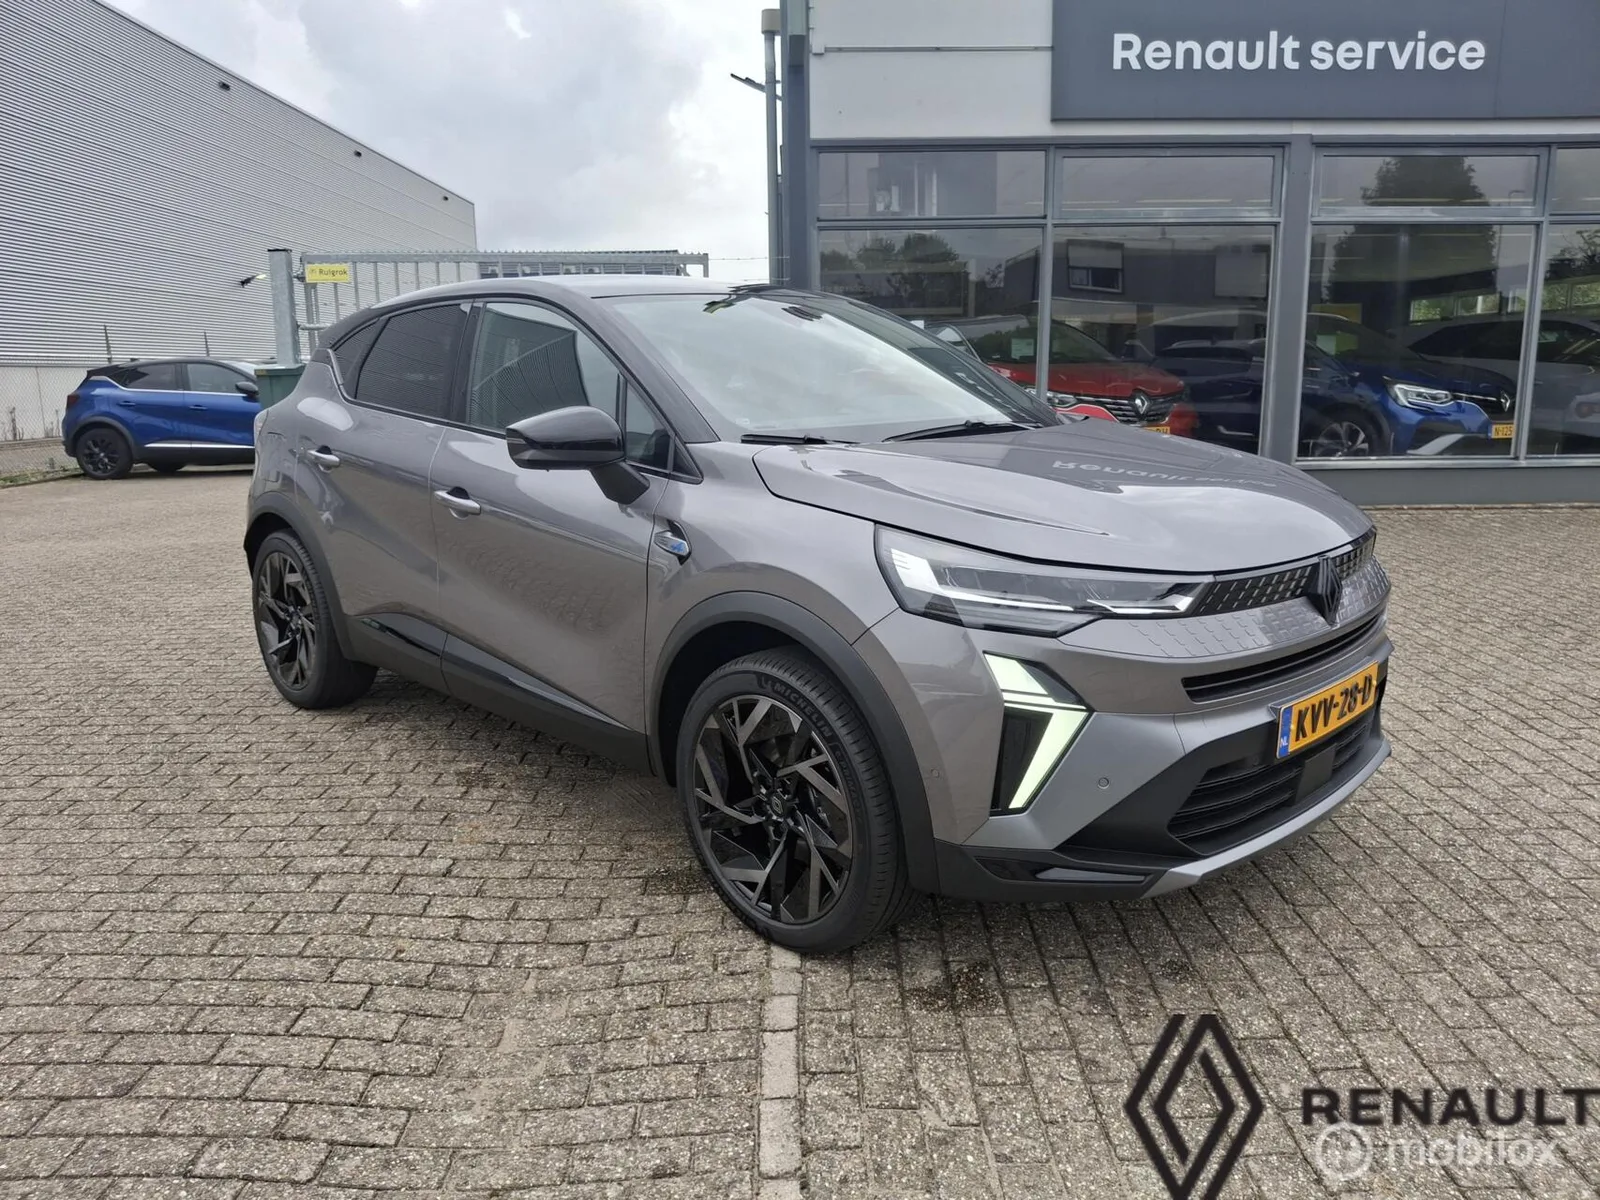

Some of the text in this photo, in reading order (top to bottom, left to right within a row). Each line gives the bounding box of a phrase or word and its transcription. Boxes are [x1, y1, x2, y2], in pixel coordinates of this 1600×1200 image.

[1112, 30, 1486, 71] Renault service
[773, 682, 834, 738] MICHELIN
[1295, 674, 1373, 742] KVV-28-D
